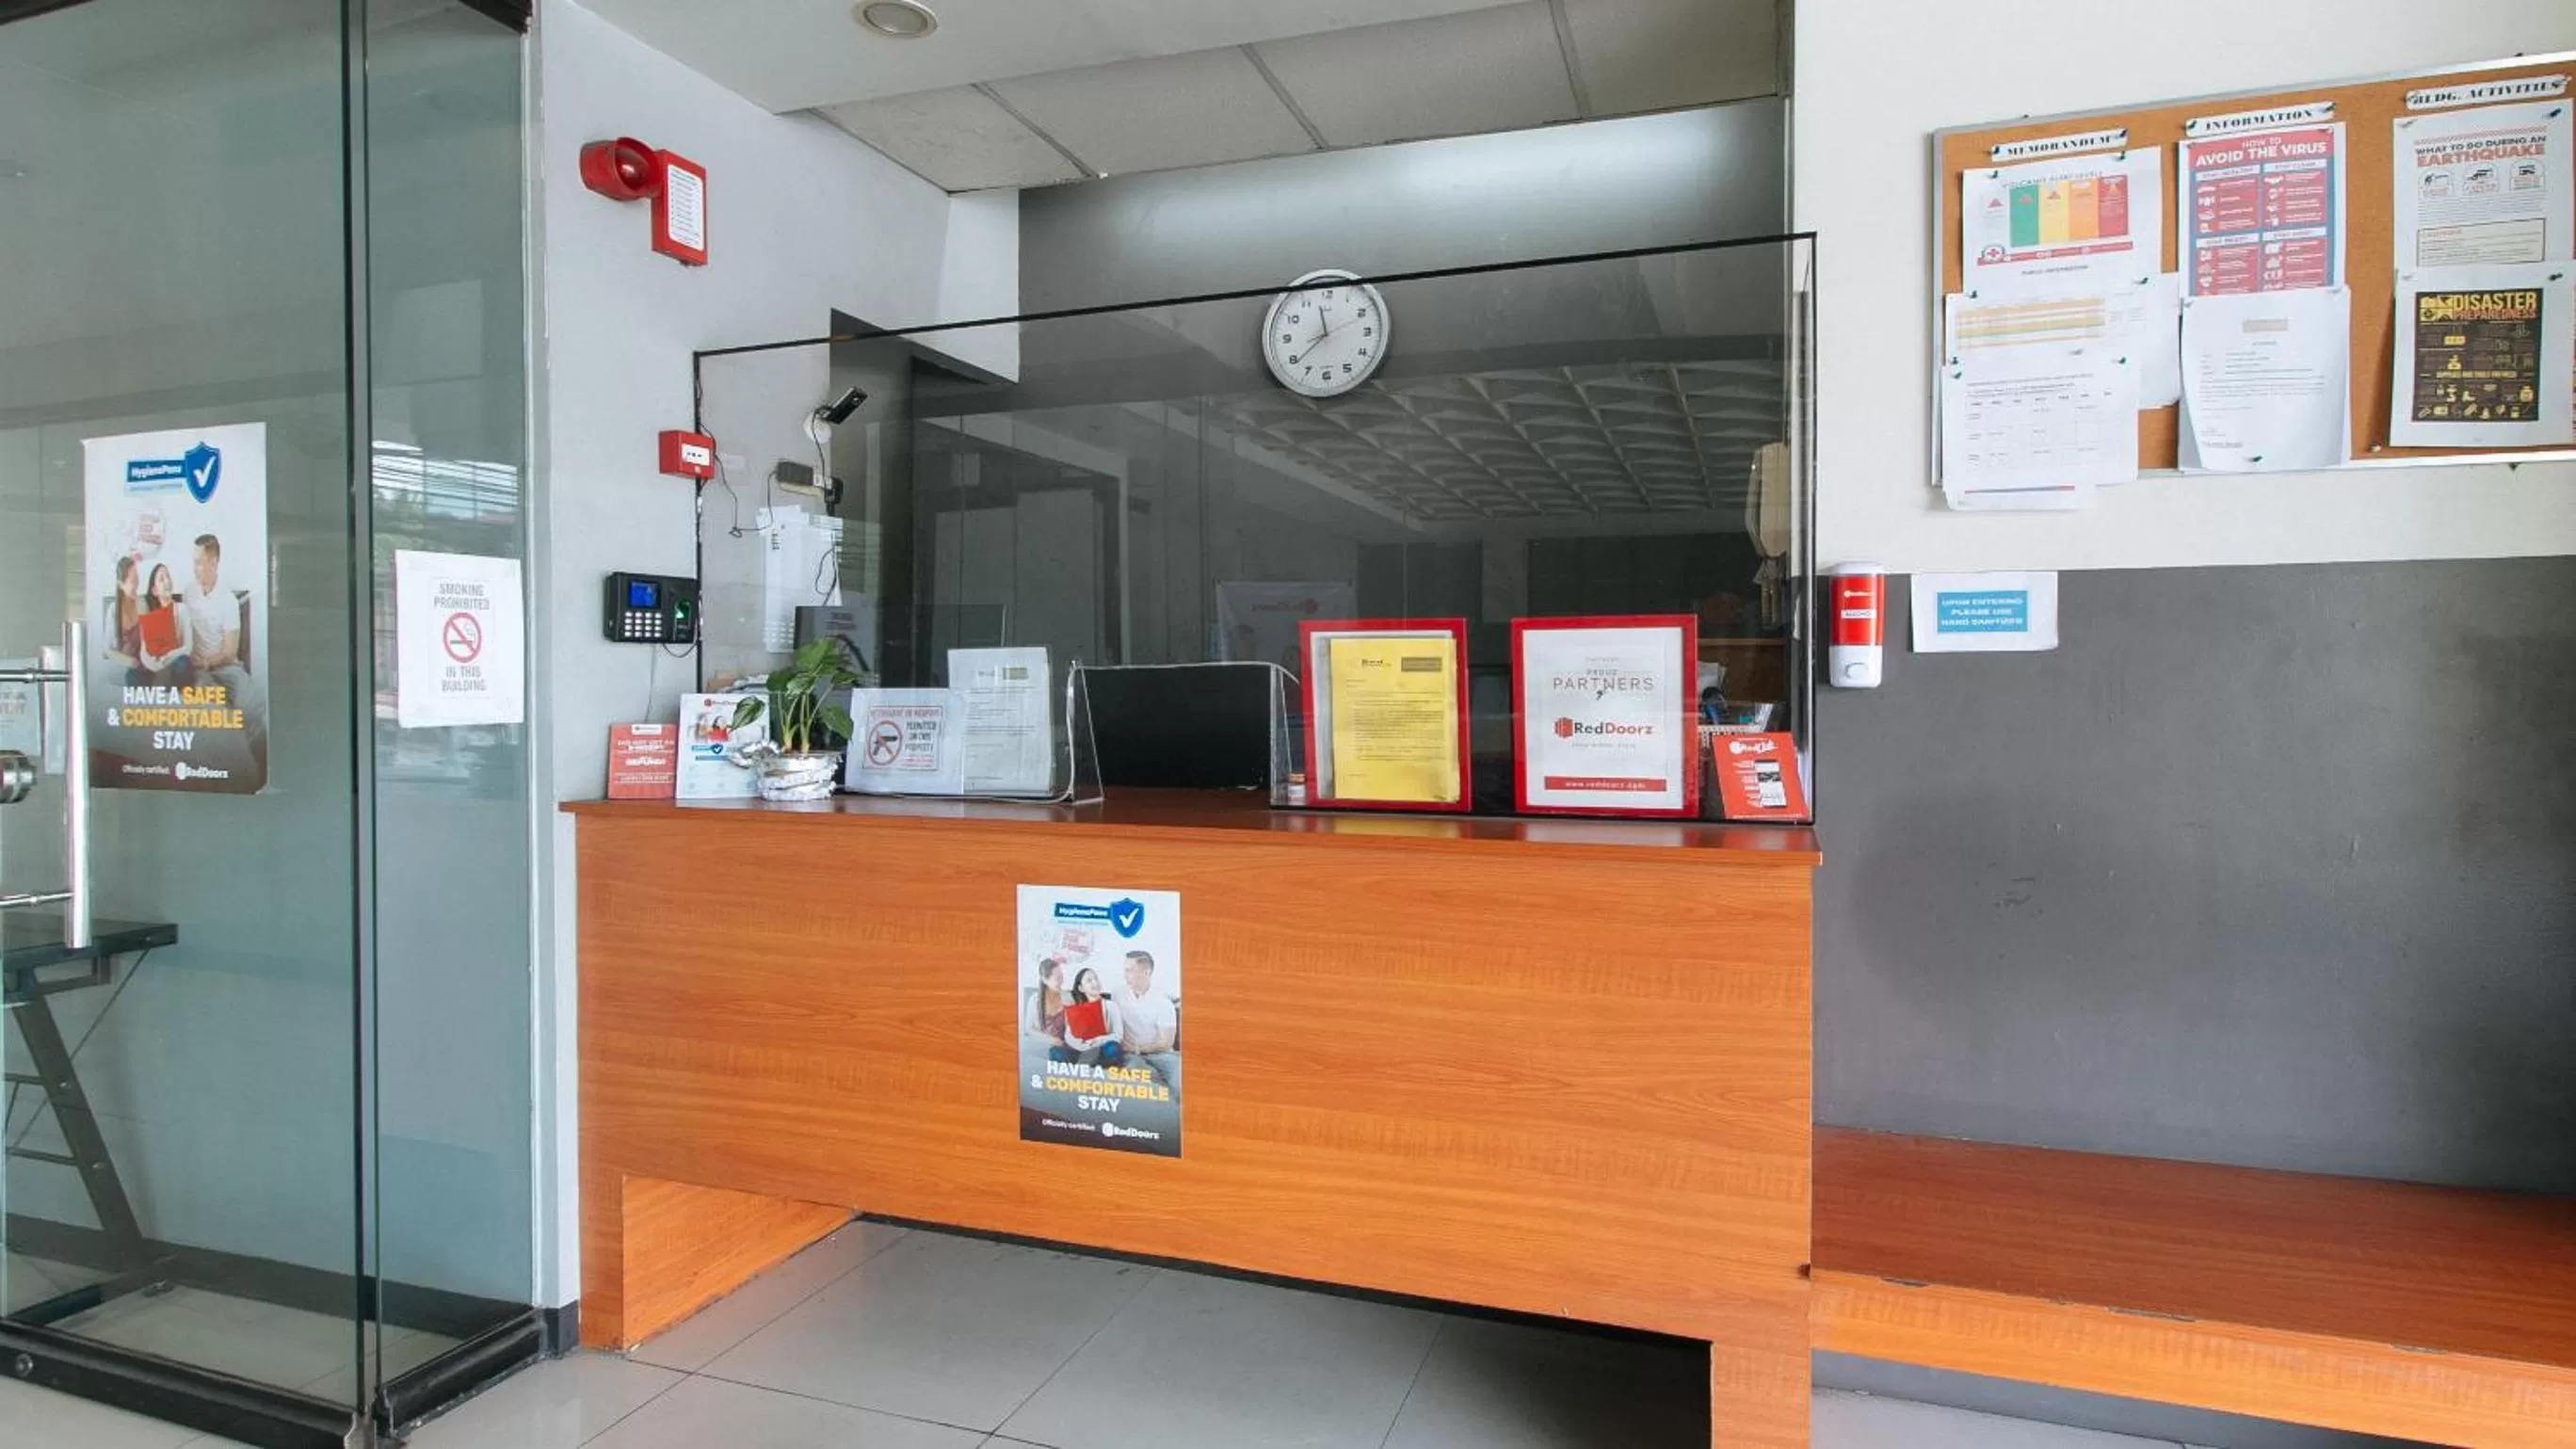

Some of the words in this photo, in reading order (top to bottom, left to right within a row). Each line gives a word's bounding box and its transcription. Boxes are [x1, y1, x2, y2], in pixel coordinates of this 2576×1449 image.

[2205, 108, 2313, 130] INFORMATION
[2007, 136, 2111, 155] MEMORANDUM
[2415, 144, 2448, 155] WHAT
[2450, 143, 2464, 152] TO
[2467, 141, 2483, 151] DO
[2486, 137, 2527, 149] DURING
[2530, 135, 2546, 144] AN
[2196, 151, 2244, 168] AVOID
[2248, 147, 2278, 160] THE
[2282, 141, 2327, 155] VIRUS
[2417, 143, 2547, 168] EARTHQUAKE
[2453, 292, 2537, 311] DISASTER
[1287, 314, 1300, 324] 10
[1282, 334, 1292, 344] 9
[1358, 347, 1367, 357] 4
[1289, 355, 1297, 364] 8
[1305, 366, 1312, 376] 7
[1343, 363, 1352, 373] 5
[1322, 371, 1331, 380] 6
[439, 583, 485, 596] SMOKING
[433, 596, 490, 610] PROHIBITED
[445, 666, 456, 678] IN
[459, 665, 481, 678] THIS
[441, 679, 487, 692] BUILDING
[1553, 677, 1654, 690] PARTNERS
[122, 685, 166, 705] HAVE
[169, 686, 181, 705] A
[182, 685, 227, 705] SAFE
[106, 707, 120, 727] &
[122, 707, 244, 730] COMFORTABLE
[1573, 721, 1654, 734] RedDoorz
[153, 730, 195, 750] STAY
[1046, 1060, 1090, 1078] HAVE
[1092, 1066, 1105, 1080] A
[1107, 1066, 1152, 1084] SAFE
[1031, 1073, 1043, 1089] &
[1045, 1076, 1170, 1102] COMFORTABLE
[1077, 1094, 1120, 1113] STAY
